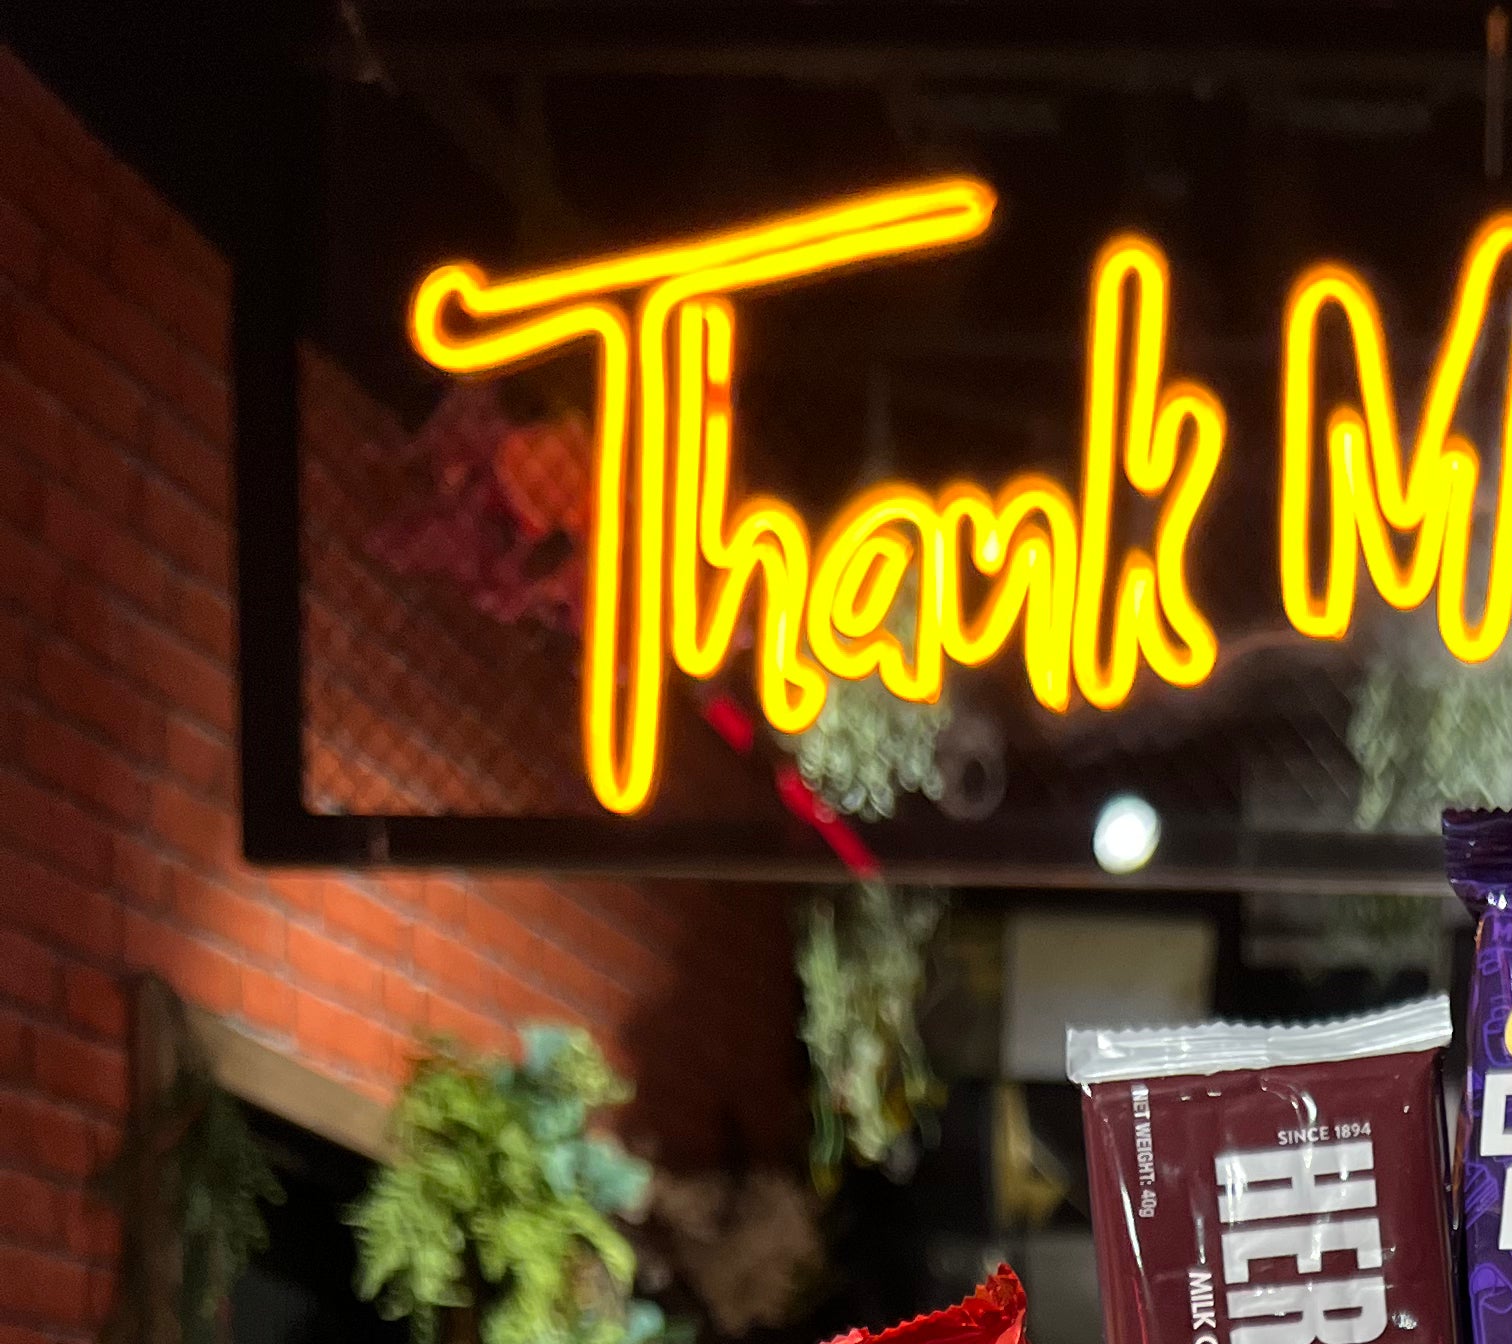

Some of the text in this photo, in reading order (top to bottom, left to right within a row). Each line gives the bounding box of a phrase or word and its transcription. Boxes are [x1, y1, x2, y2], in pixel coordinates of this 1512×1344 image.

[412, 175, 1228, 817] Thank
[1134, 1122, 1155, 1186] WEIGHT:
[1277, 1121, 1371, 1145] SINCE 1894
[1139, 1188, 1156, 1219] 40g
[1187, 1269, 1216, 1330] MILK
